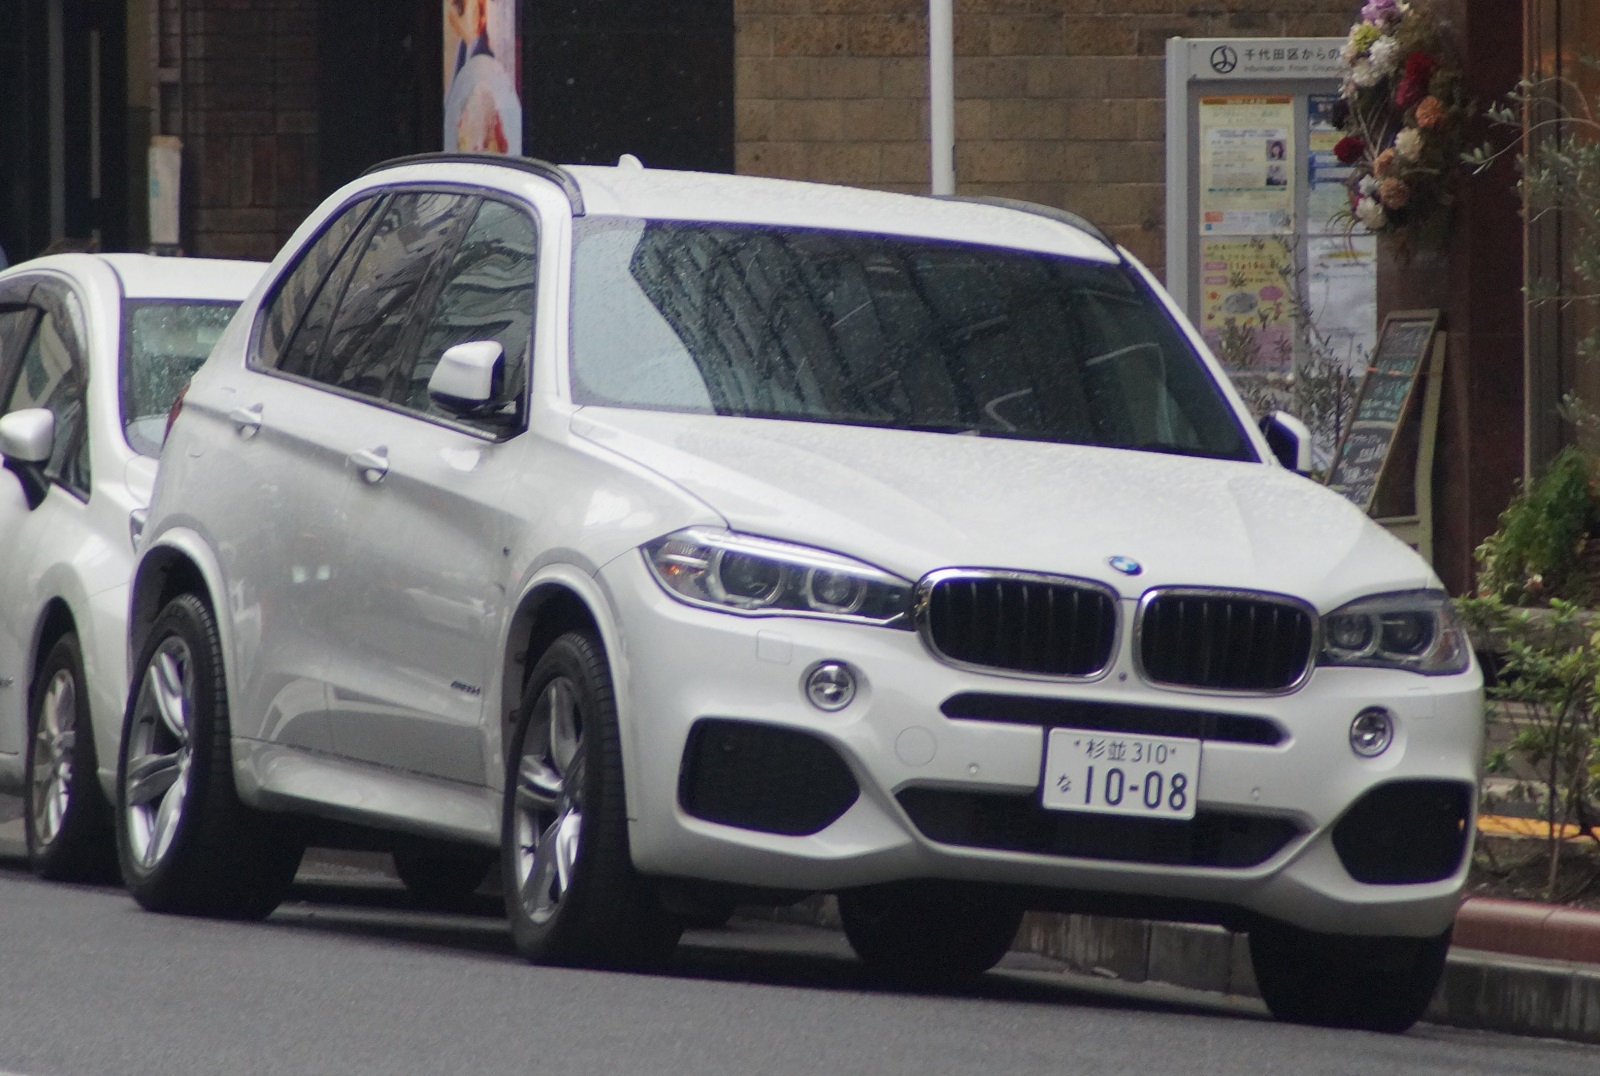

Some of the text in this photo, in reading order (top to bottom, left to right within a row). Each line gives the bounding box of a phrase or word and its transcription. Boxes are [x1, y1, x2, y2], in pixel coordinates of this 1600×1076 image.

[1244, 48, 1340, 60] 千代田区からの
[1056, 765, 1187, 811] な 10-08
